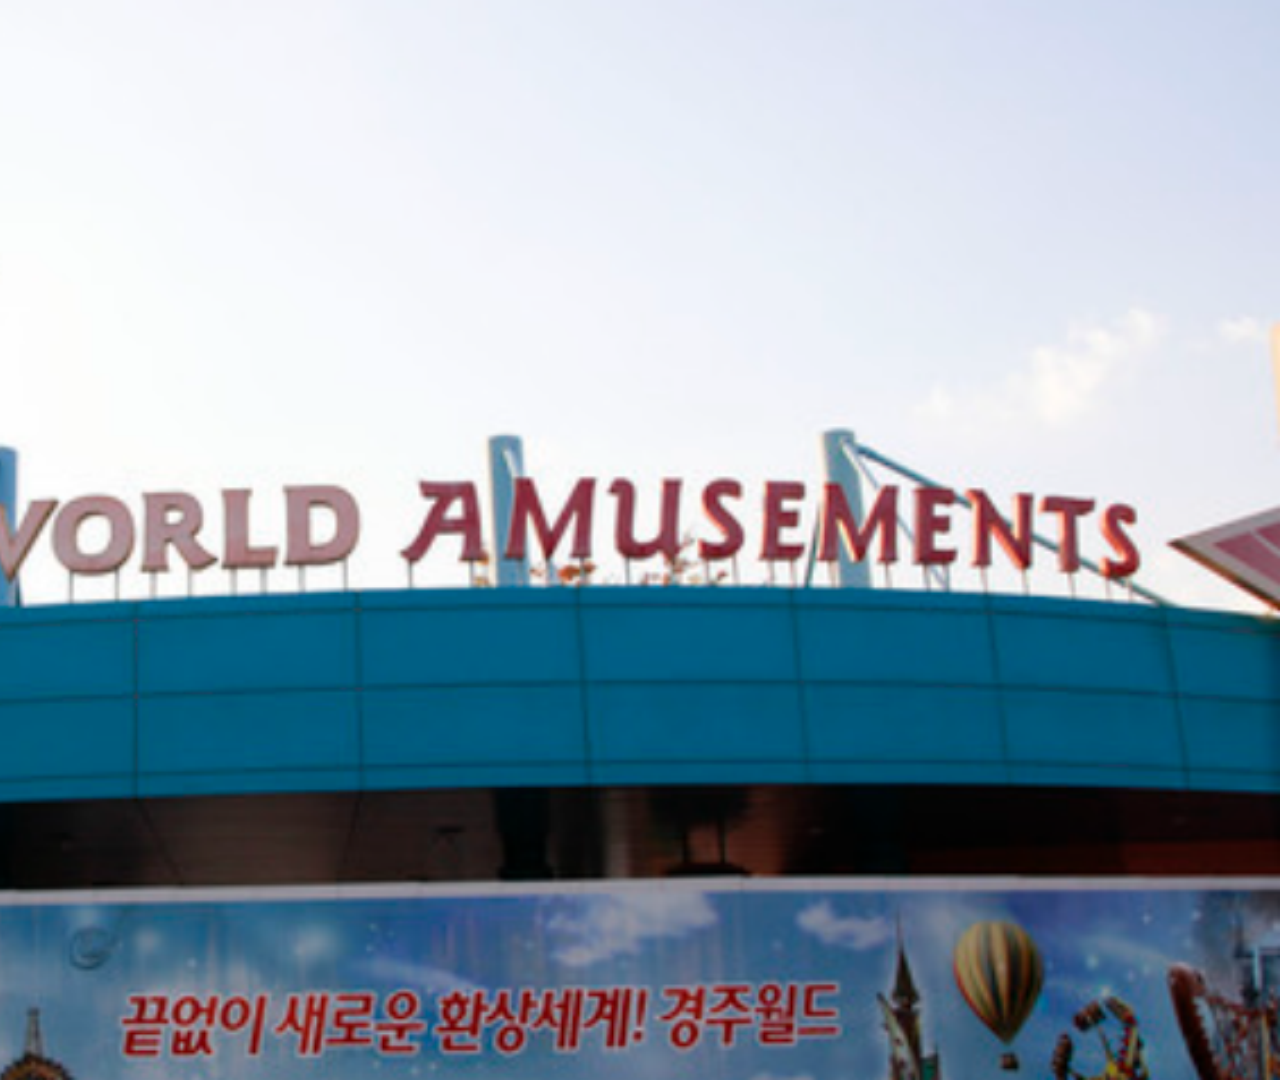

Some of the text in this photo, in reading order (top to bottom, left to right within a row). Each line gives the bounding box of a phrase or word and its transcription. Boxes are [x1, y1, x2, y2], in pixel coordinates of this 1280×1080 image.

[400, 477, 1142, 578] AMUSEMENTS
[121, 983, 842, 1057] 끝없이 새로운 환상세계! 경주월드
